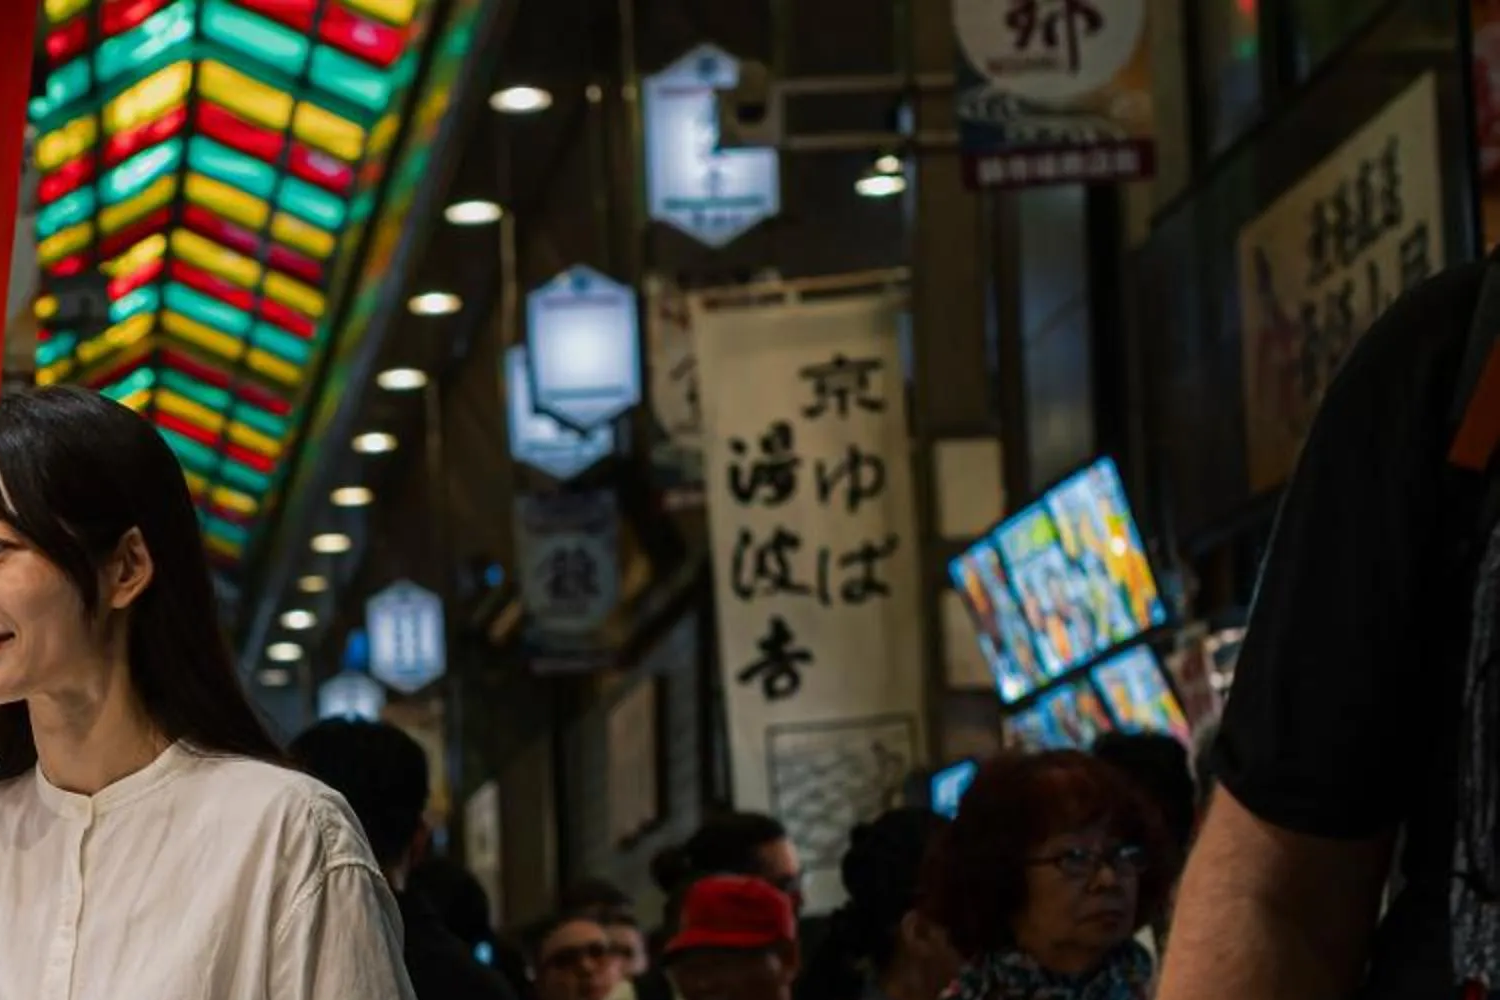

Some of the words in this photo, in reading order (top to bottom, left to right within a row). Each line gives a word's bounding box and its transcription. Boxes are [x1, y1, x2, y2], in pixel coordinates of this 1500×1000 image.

[727, 419, 814, 701] 湯波吉
[798, 352, 898, 608] 京ゆば
